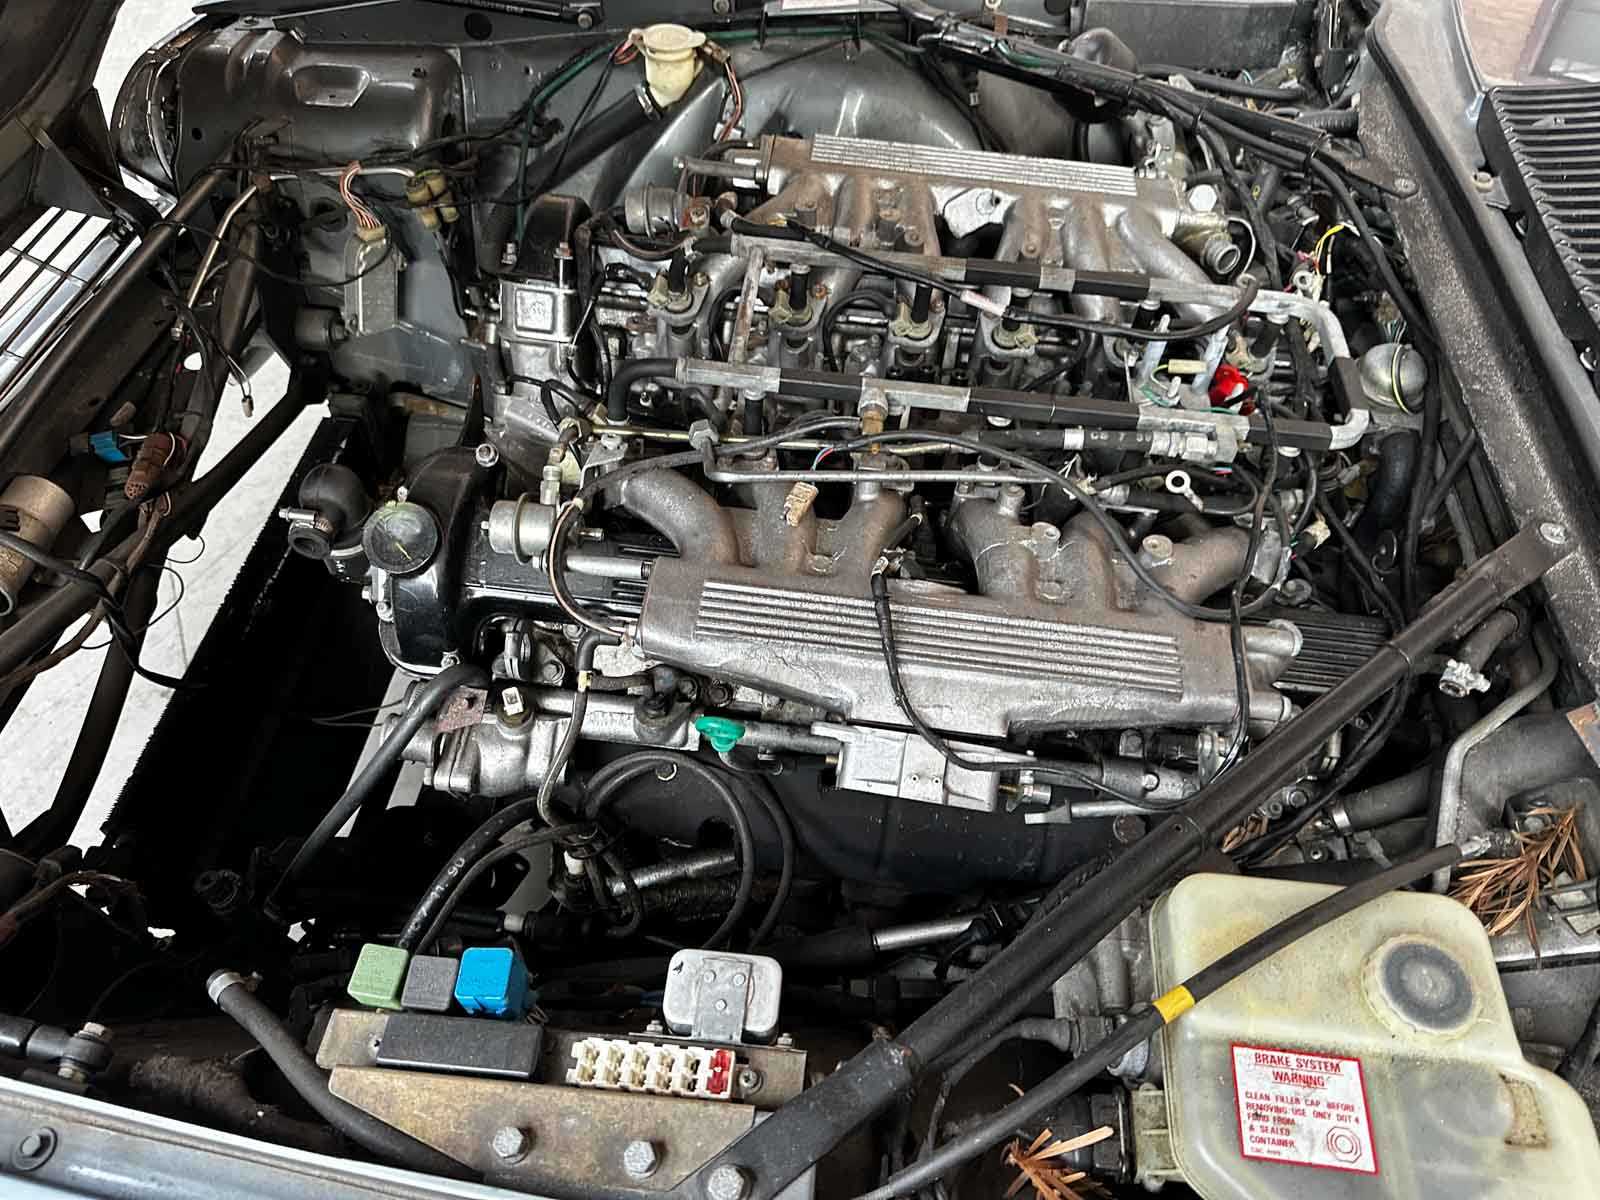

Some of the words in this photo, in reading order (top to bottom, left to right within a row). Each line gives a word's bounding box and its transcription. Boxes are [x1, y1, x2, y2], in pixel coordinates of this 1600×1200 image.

[1254, 1051, 1291, 1066] BRAKE
[1295, 1057, 1342, 1073] SYSTEM
[1271, 1070, 1325, 1087] WARNING
[1245, 1091, 1270, 1101] CLEAN
[1275, 1095, 1301, 1105] FILLER
[1304, 1098, 1321, 1107] CAP
[1326, 1102, 1355, 1112] BEFORE
[1272, 1116, 1296, 1126] FROM
[1291, 1107, 1307, 1117] USE
[1312, 1110, 1331, 1120] ONLY
[1336, 1114, 1351, 1123] DOT
[1260, 1125, 1290, 1136] SEALED
